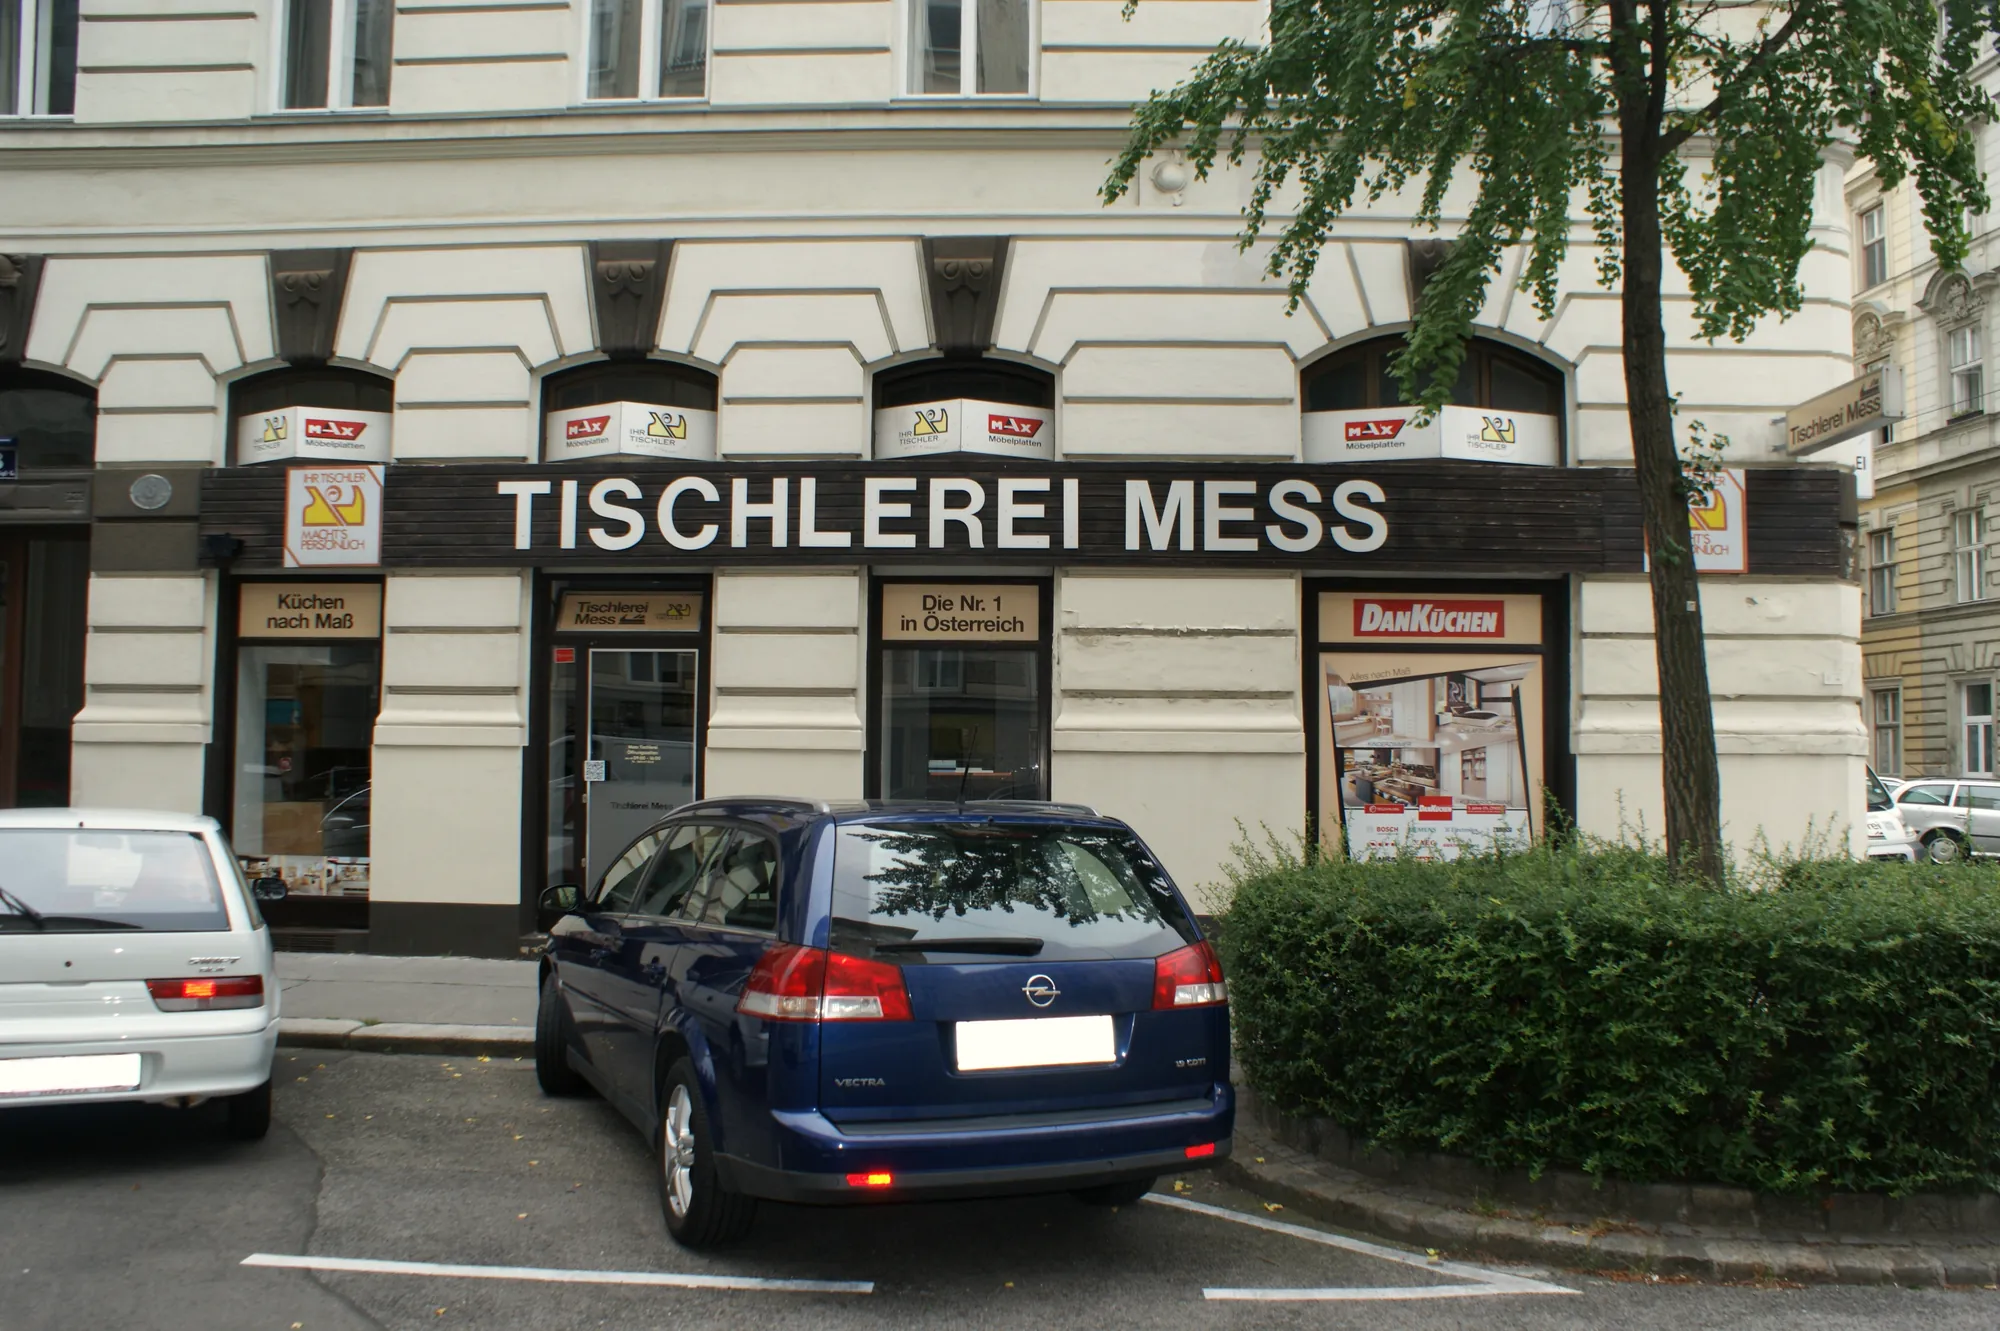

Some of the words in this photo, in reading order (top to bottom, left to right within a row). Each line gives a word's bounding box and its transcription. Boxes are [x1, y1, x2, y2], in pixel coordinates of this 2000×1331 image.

[1789, 406, 1844, 445] Tischlerei
[1846, 396, 1881, 423] Mess
[630, 428, 646, 436] IHR
[1466, 433, 1480, 441] IHR
[305, 439, 366, 450] Möbelplatten
[566, 437, 609, 448] Möbelplatten
[630, 435, 676, 446] TISCHLER
[899, 435, 939, 445] TISCHLER
[988, 435, 1042, 448] Möbelplatten
[1345, 440, 1406, 450] Möbelplatten
[1467, 441, 1507, 450] TISCHLER
[303, 473, 319, 483] IHR
[320, 472, 366, 483] TISCHLER
[498, 476, 1079, 550] TISCHLEREI
[1125, 479, 1388, 552] MESS
[278, 592, 345, 610] Küchen
[922, 594, 954, 612] Die
[960, 595, 986, 612] Nr.
[993, 595, 1001, 612] 1
[576, 601, 649, 614] Tischlerei
[266, 613, 310, 629] nach
[315, 613, 354, 630] Maß
[574, 614, 616, 625] Mess
[900, 615, 918, 632] in
[923, 611, 1025, 633] Österreich
[1350, 671, 1369, 681] Alles
[1370, 669, 1391, 679] nach
[1392, 666, 1411, 677] Maß
[835, 1077, 885, 1087] VECTRA
